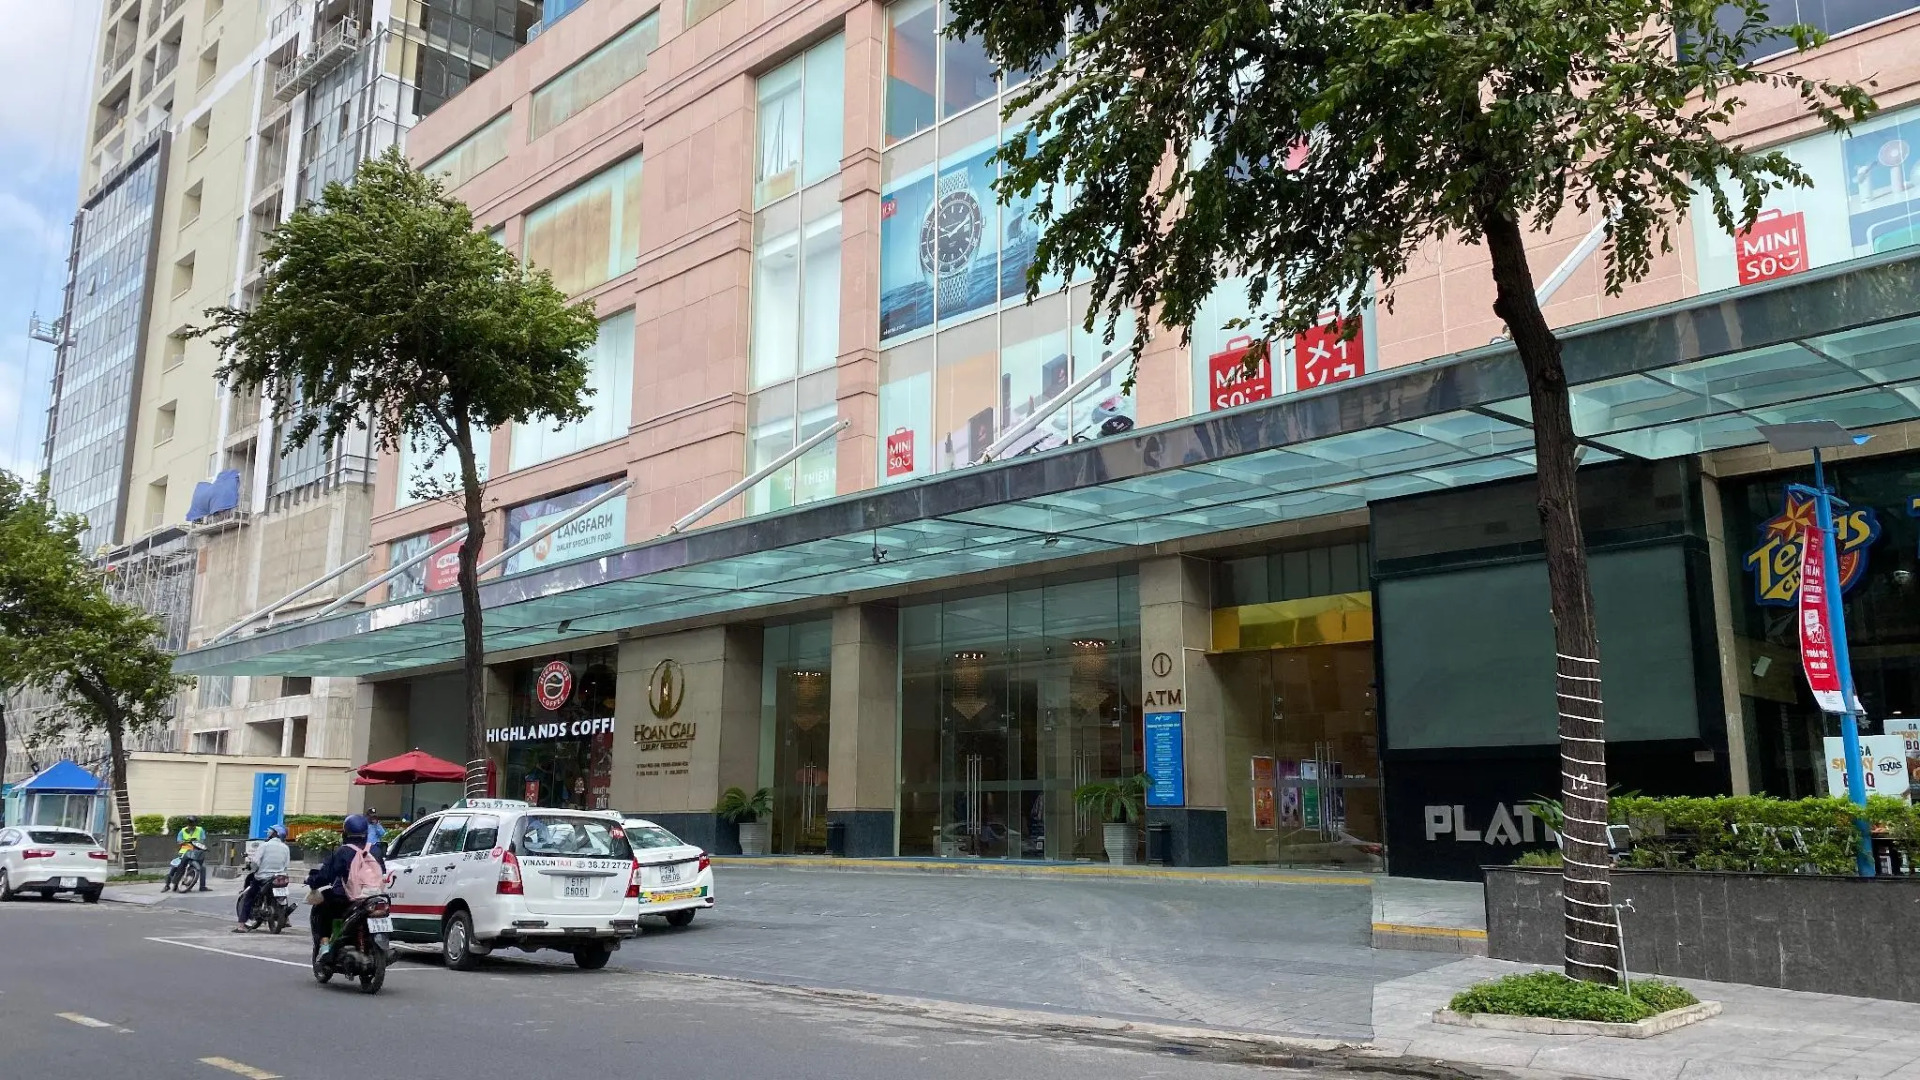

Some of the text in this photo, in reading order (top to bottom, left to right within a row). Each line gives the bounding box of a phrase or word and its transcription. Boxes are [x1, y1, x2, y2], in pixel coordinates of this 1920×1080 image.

[1743, 227, 1798, 256] MINI
[889, 440, 911, 455] MINI
[557, 512, 613, 539] LANGFARM
[1144, 689, 1182, 706] ATM
[486, 717, 615, 742] HIGHLANDS COFF
[1905, 740, 1920, 750] BQ
[1878, 761, 1902, 772] TEXAS
[266, 804, 275, 815] P
[523, 859, 556, 867] VINASUN
